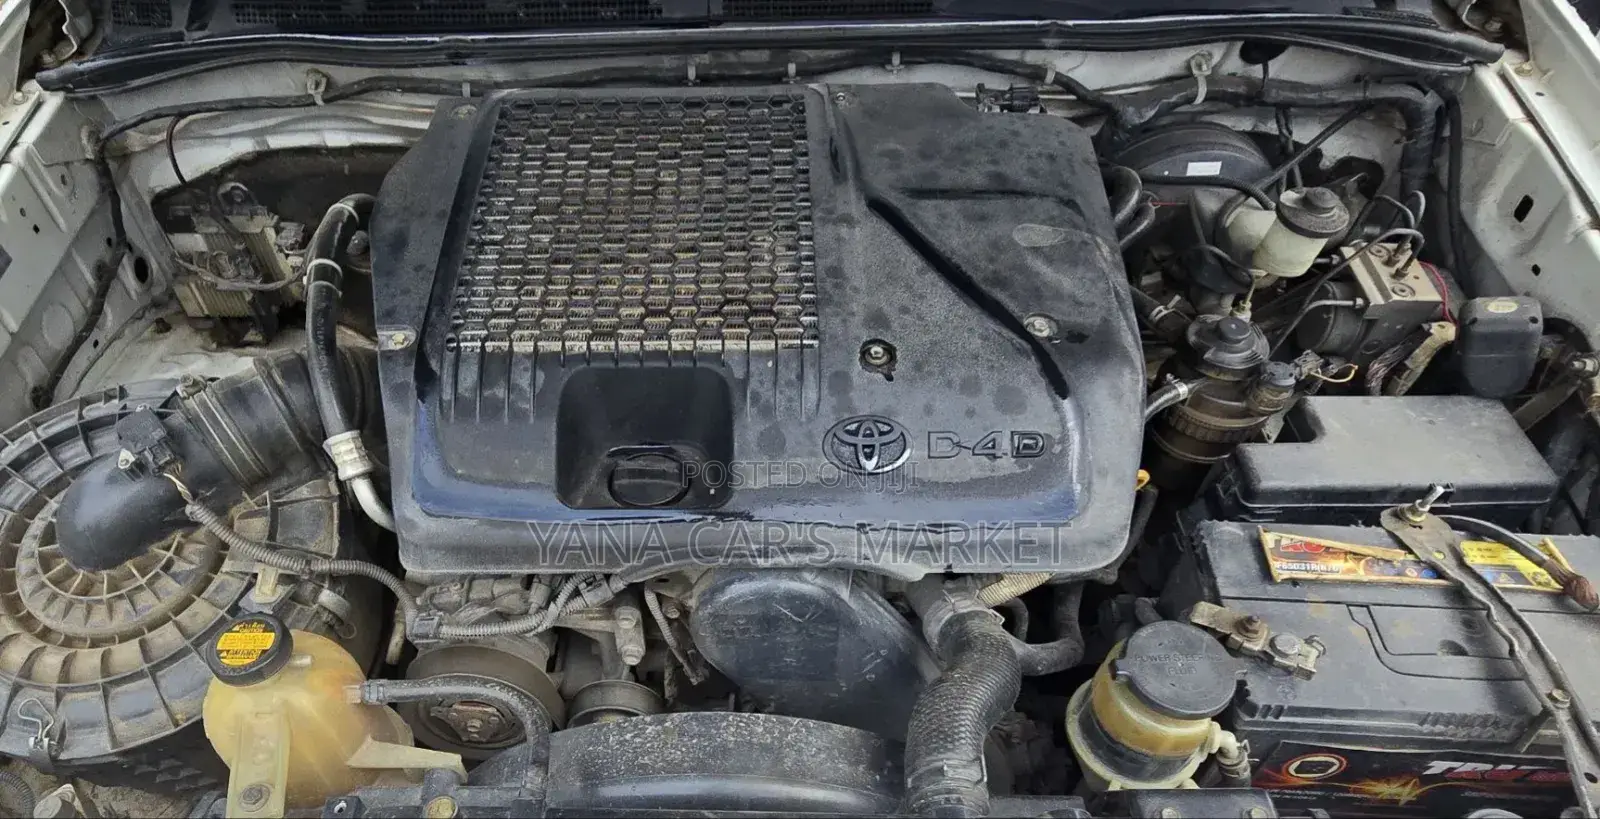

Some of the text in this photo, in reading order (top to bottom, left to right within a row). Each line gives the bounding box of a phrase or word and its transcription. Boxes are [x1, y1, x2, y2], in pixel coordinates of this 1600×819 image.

[927, 430, 1045, 459] D-4D
[1134, 654, 1170, 662] POWER
[1167, 666, 1197, 675] FLUID
